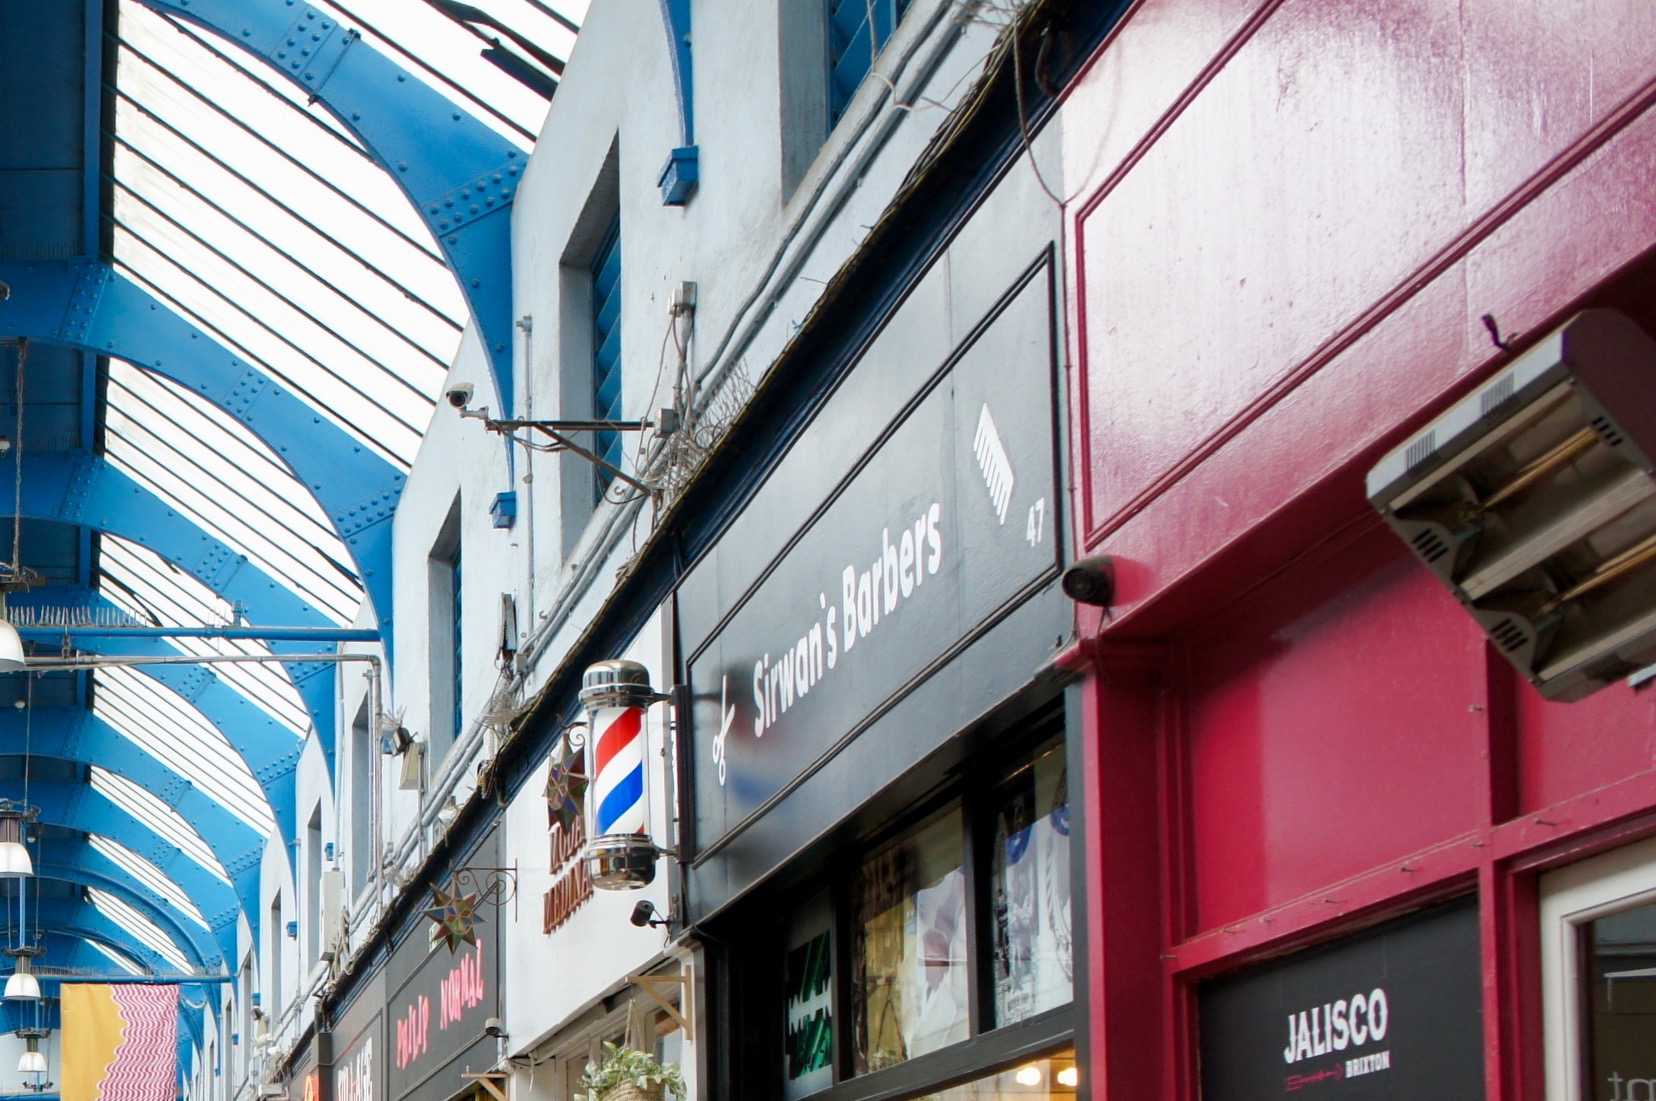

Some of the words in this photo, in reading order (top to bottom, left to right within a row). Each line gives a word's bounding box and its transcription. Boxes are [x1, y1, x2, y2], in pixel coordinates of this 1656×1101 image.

[1025, 496, 1044, 547] 47
[754, 593, 837, 738] Sirwan's
[843, 502, 941, 652] Barbers
[1283, 987, 1389, 1064] JALISCO
[1346, 1050, 1390, 1079] BRIXTON
